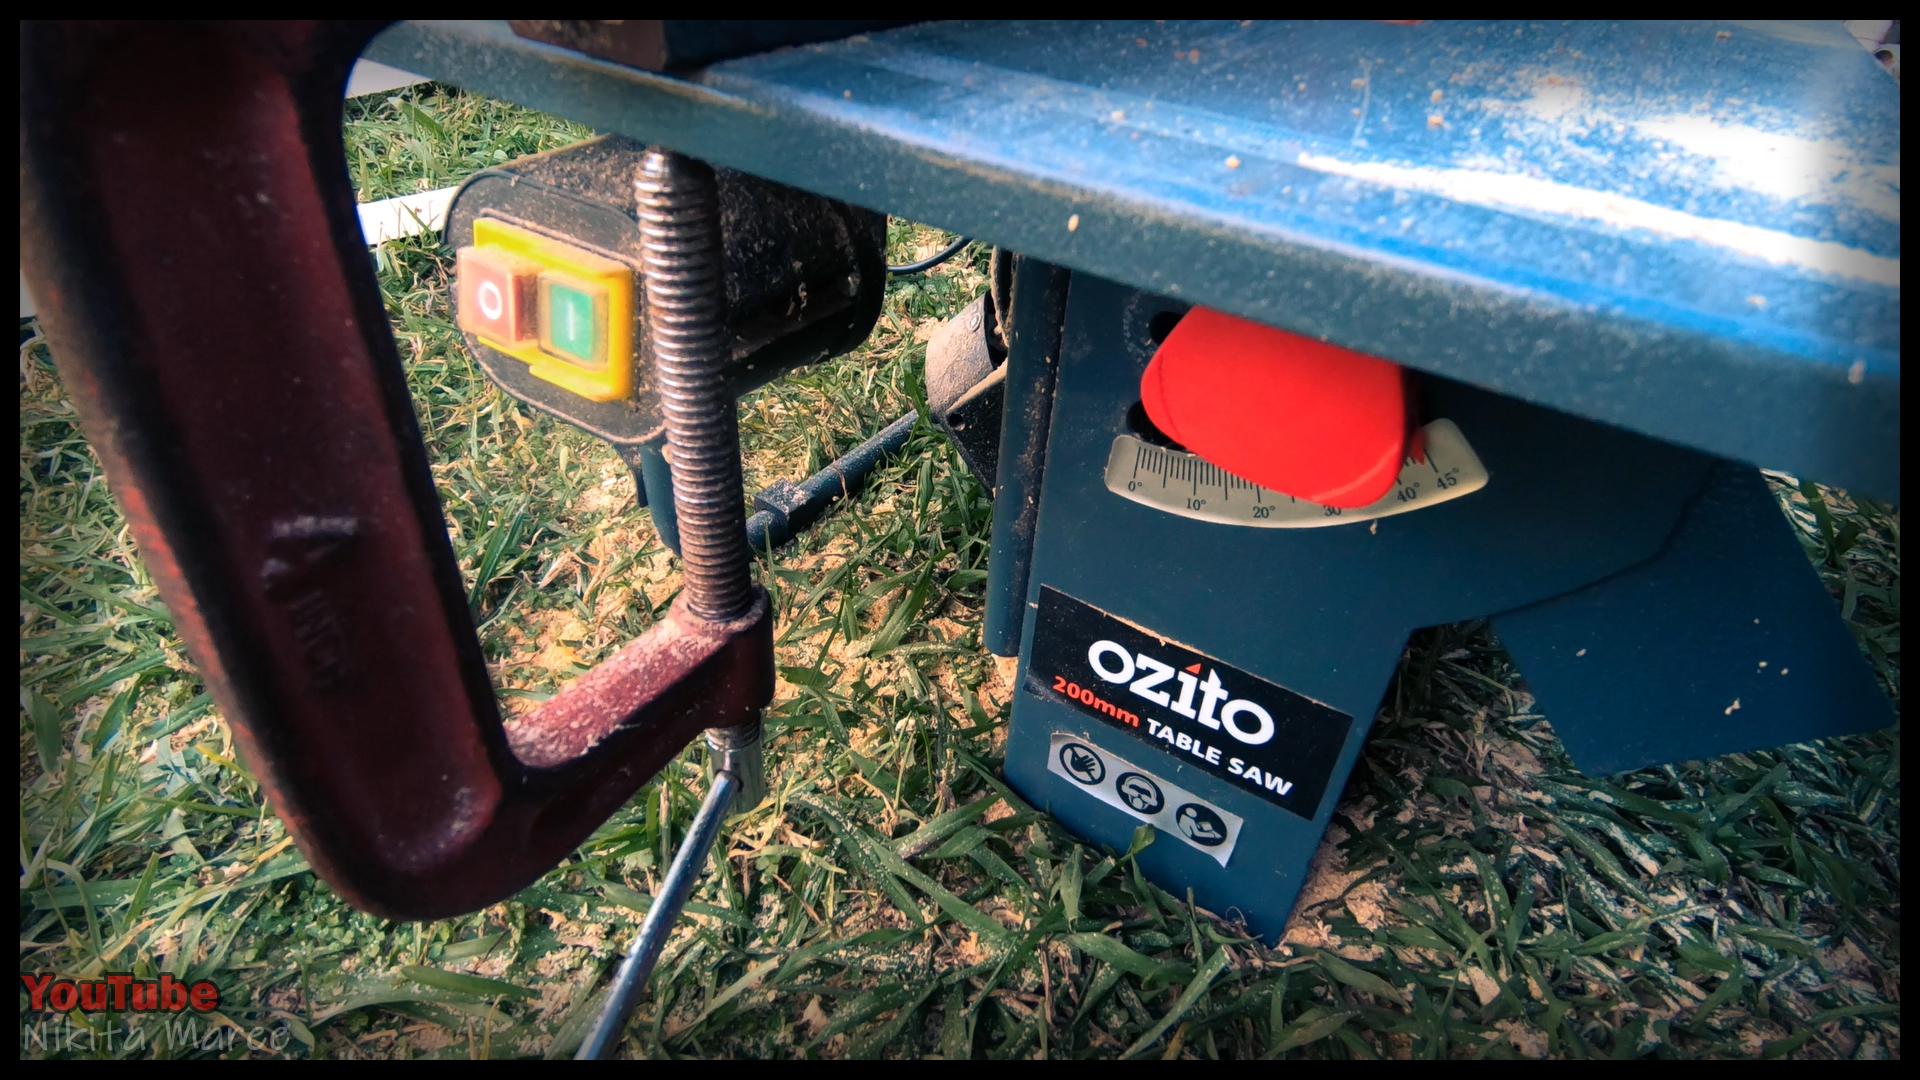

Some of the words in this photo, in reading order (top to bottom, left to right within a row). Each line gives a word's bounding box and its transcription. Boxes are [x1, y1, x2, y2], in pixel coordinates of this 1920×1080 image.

[1186, 497, 1206, 511] 10°
[1252, 505, 1275, 518] 20°
[1436, 467, 1460, 490] 45°
[1052, 675, 1140, 728] 200mm
[1147, 718, 1223, 765] TABLE
[1227, 756, 1293, 797] SAW
